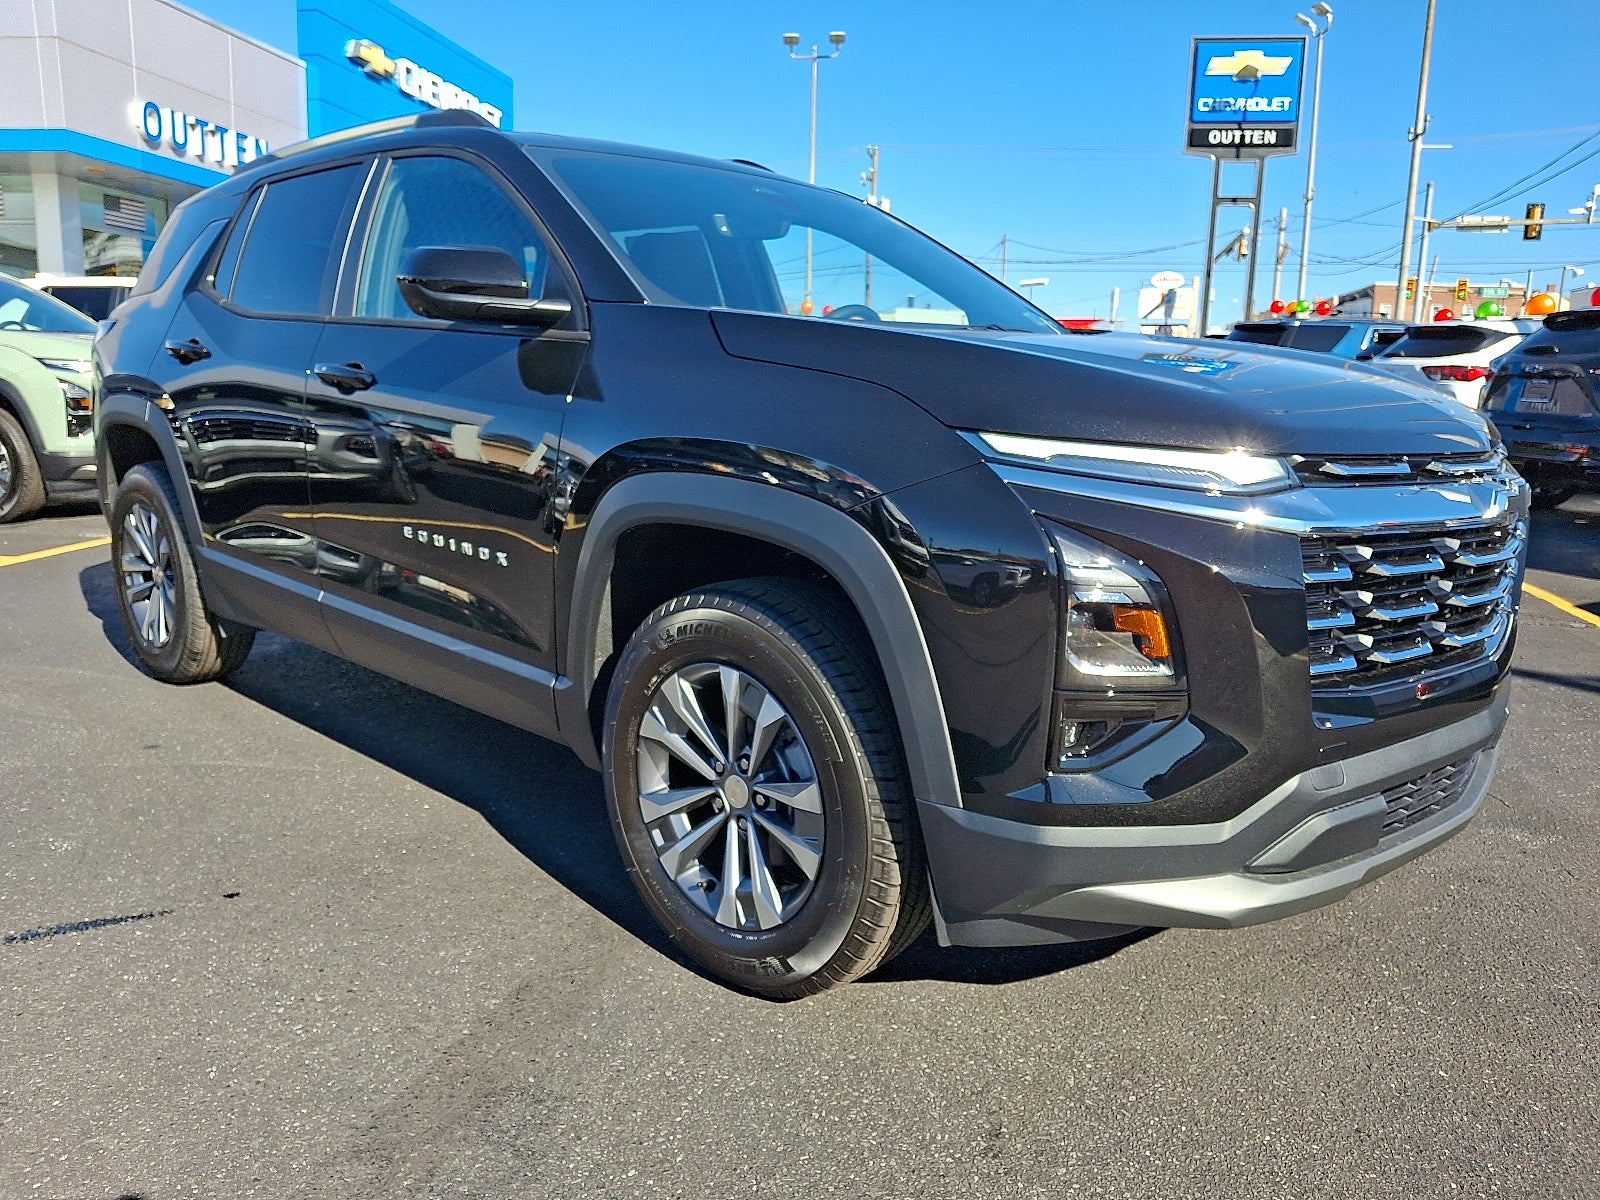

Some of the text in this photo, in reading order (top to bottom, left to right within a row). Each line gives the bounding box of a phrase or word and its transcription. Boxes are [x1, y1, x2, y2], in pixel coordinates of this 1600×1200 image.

[1197, 97, 1293, 112] CHEVROLET
[135, 100, 269, 168] OUTTEN
[1208, 129, 1277, 145] OUTTEN
[402, 525, 508, 567] EQUINOX
